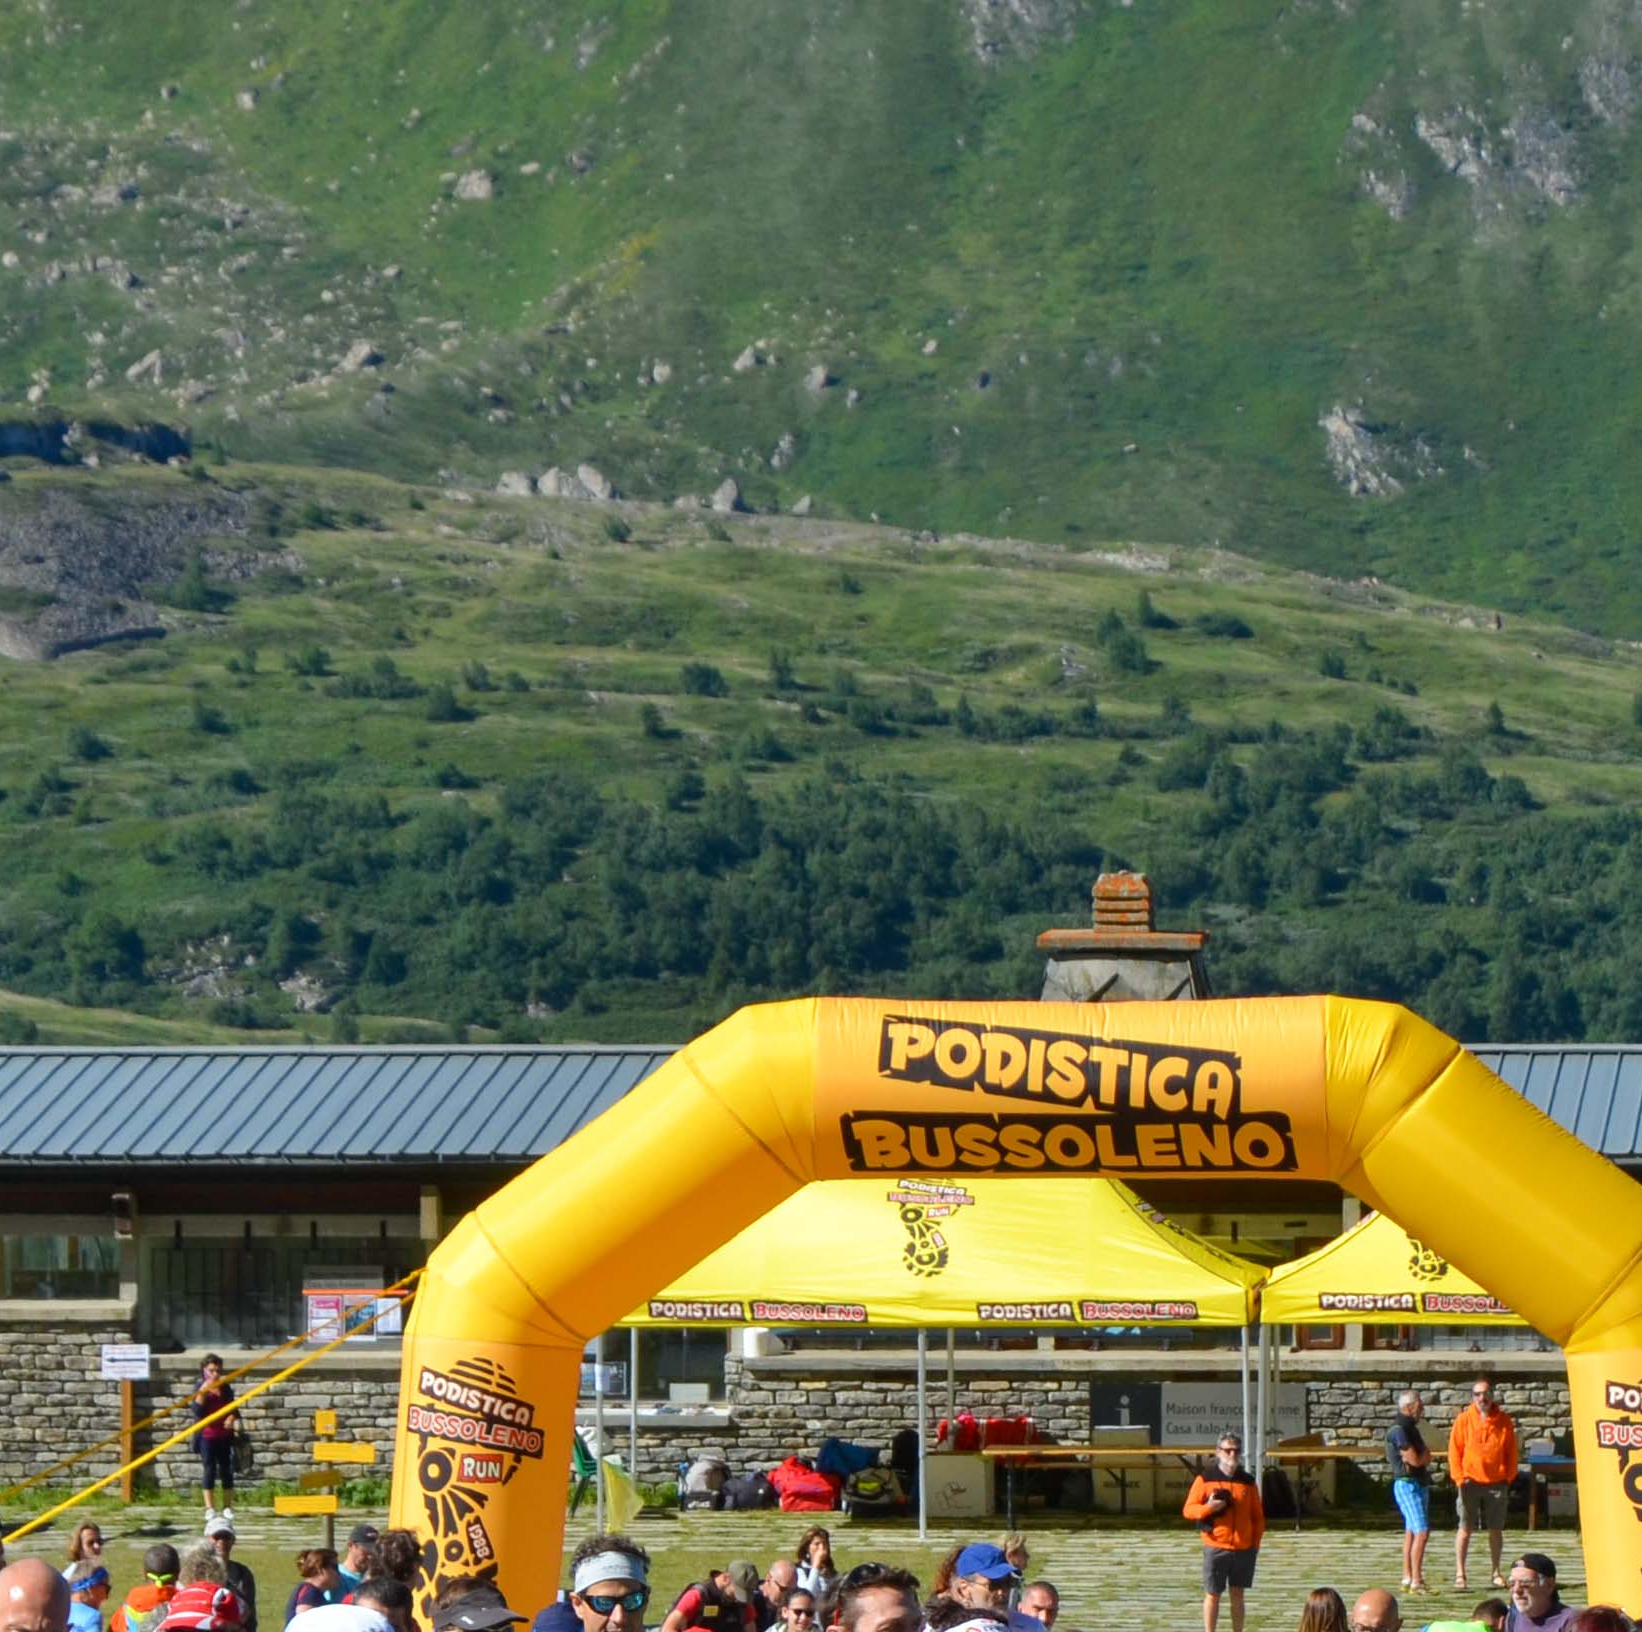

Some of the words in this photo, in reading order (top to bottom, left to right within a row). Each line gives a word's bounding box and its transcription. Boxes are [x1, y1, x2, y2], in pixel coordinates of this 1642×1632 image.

[886, 1021, 1236, 1114] PODISTICA
[855, 1120, 1287, 1168] BUSSOLENO
[650, 1302, 742, 1319] PODISTICA
[754, 1302, 865, 1321] BUSSOLENO
[979, 1302, 1071, 1319] PODISTICA
[1083, 1302, 1195, 1320] BUSSOLENO
[1321, 1293, 1412, 1310] PODISTICA
[420, 1370, 531, 1424] PODISTICA
[1166, 1402, 1207, 1415] Maison
[409, 1407, 542, 1451] BUSSOLENO
[1166, 1422, 1192, 1435] Casa
[461, 1459, 501, 1480] RUN
[468, 1523, 489, 1558] 1988
